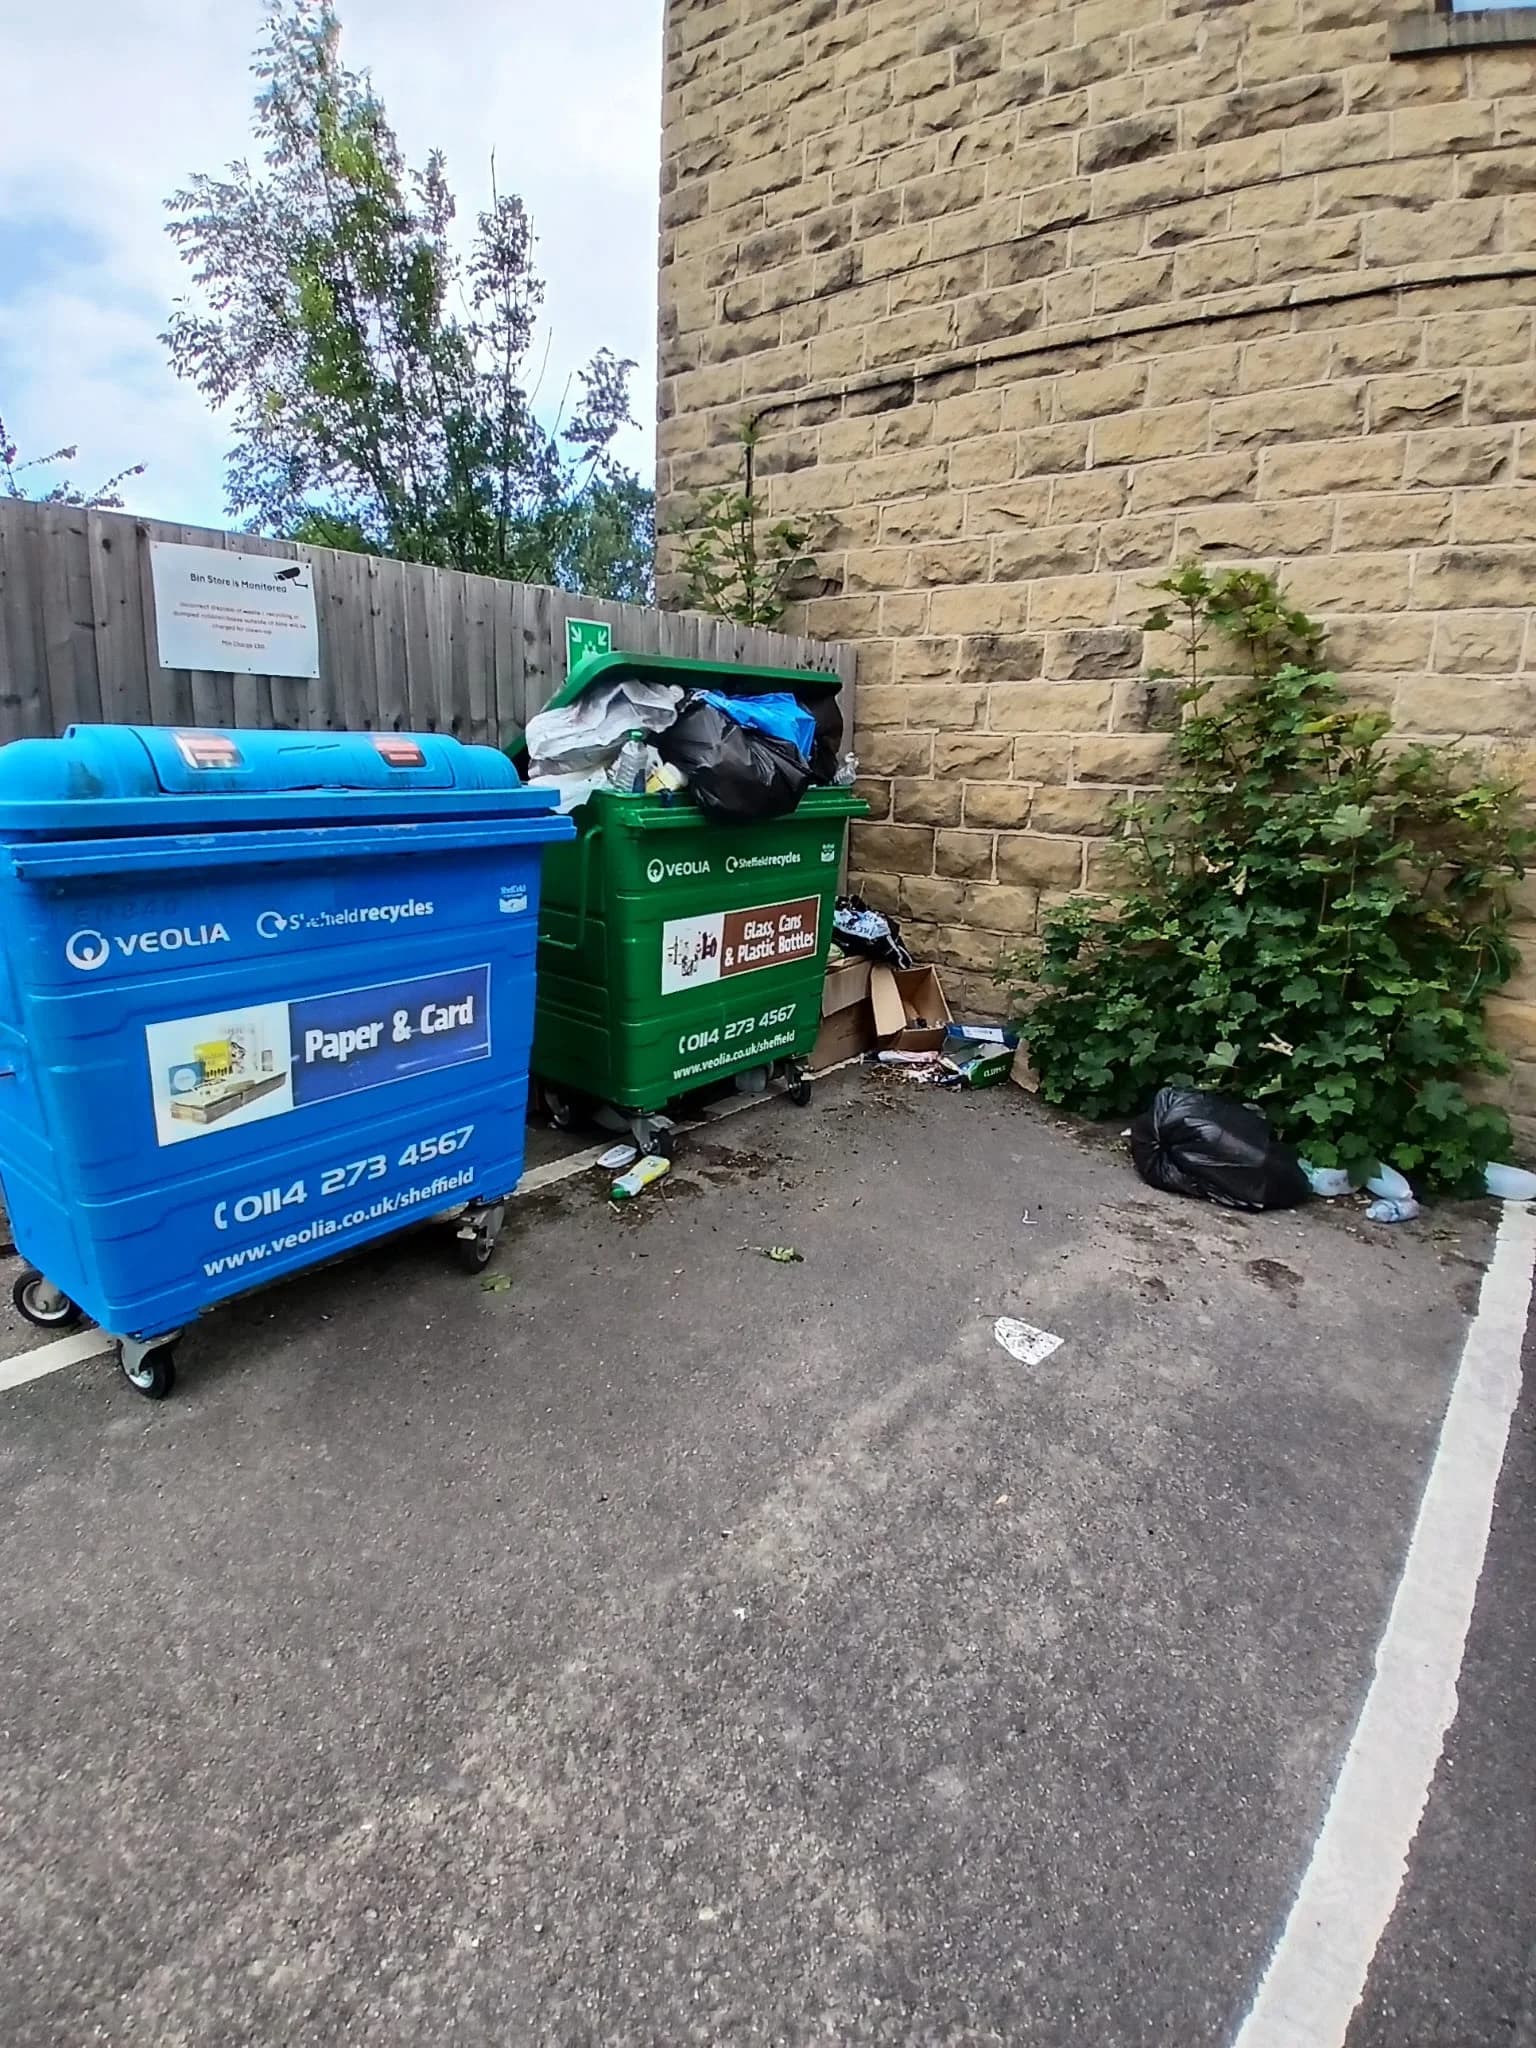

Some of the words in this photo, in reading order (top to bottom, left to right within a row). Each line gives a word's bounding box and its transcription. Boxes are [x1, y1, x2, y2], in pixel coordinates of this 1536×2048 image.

[190, 573, 206, 583] Bin
[207, 575, 231, 587] Store
[665, 860, 711, 877] VEOLIA
[114, 923, 231, 957] VEOLIA
[743, 921, 775, 941] Glass,
[778, 913, 803, 932] Cans
[724, 947, 734, 967] &
[737, 939, 775, 965] Plastic
[778, 930, 815, 954] Bottles
[304, 1020, 384, 1063] Paper
[391, 1009, 412, 1042] &
[420, 995, 474, 1035] Card
[687, 1028, 720, 1051] 0114
[724, 1016, 755, 1041] 273
[758, 1003, 797, 1027] 4567
[672, 1030, 796, 1080] www.veolia.co.uk/sheffield
[233, 1180, 308, 1223] 0114
[320, 1153, 388, 1194] 273
[398, 1124, 475, 1168] 4567
[203, 1166, 475, 1278] www.veolia.co.uk/sheffield
